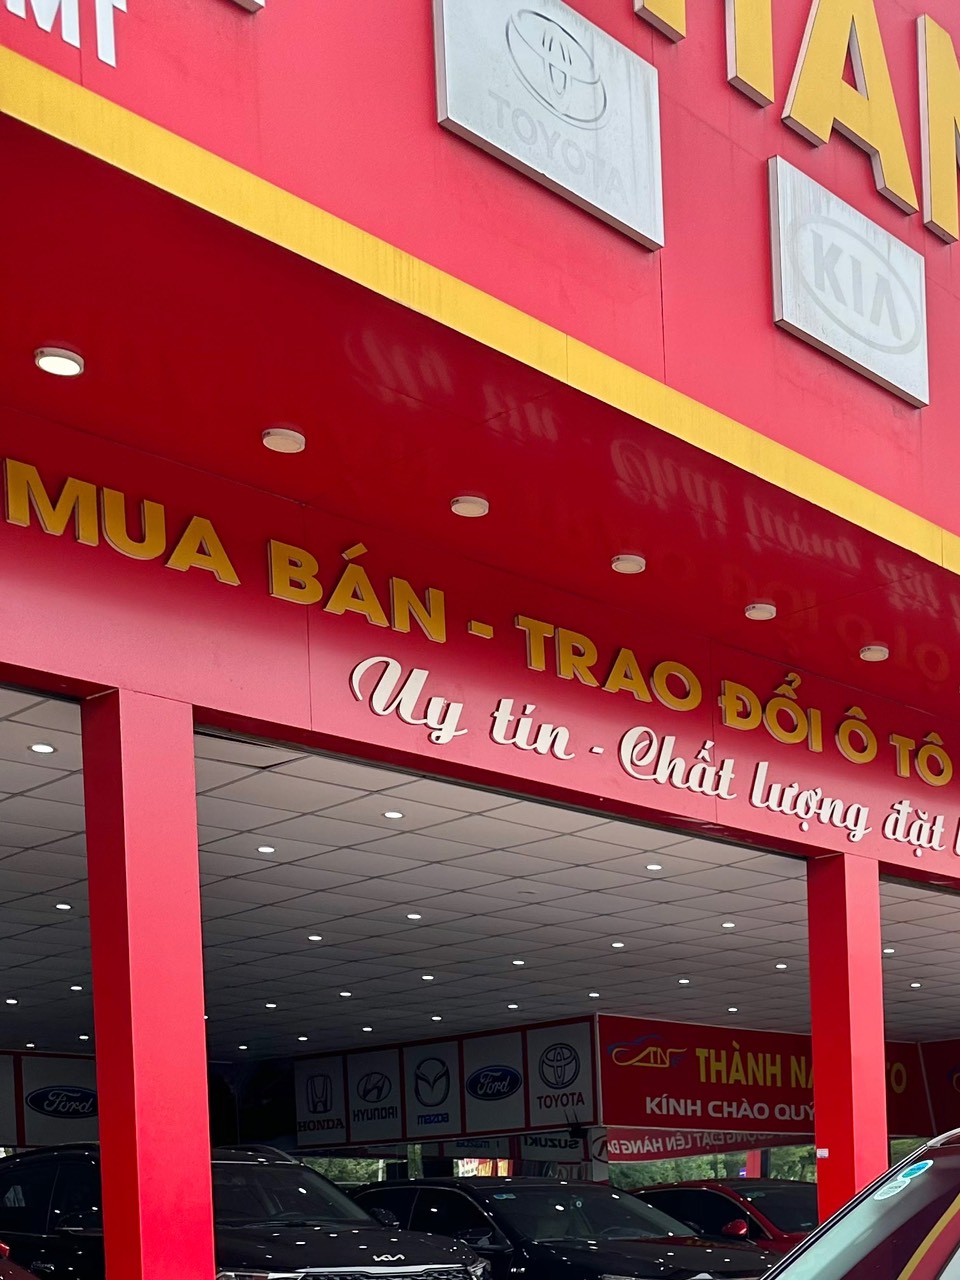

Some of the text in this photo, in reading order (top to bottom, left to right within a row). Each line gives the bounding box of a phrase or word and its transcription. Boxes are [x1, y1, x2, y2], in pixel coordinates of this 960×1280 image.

[488, 90, 628, 205] TOYOTA
[810, 229, 902, 342] KIA
[3, 458, 241, 587] MUA
[267, 539, 446, 644] BÁN
[515, 615, 703, 712] TRAO
[718, 672, 823, 753] ĐỔI
[835, 706, 878, 765] Ô
[890, 731, 953, 787] TÔ
[350, 656, 468, 744] Uy
[490, 697, 576, 760] tín
[618, 725, 737, 800] Chất
[750, 760, 872, 844] lượng
[882, 799, 946, 859] đặt
[695, 1040, 782, 1087] THÀNH
[477, 1070, 511, 1095] Ford
[44, 1090, 94, 1112] Ford
[537, 1092, 585, 1109] TOYOTA
[645, 1093, 701, 1117] KÍNH
[707, 1097, 769, 1120] CHÀO
[298, 1118, 345, 1132] HONDA
[353, 1106, 398, 1122] HYUNDAI
[417, 1112, 449, 1125] mazda
